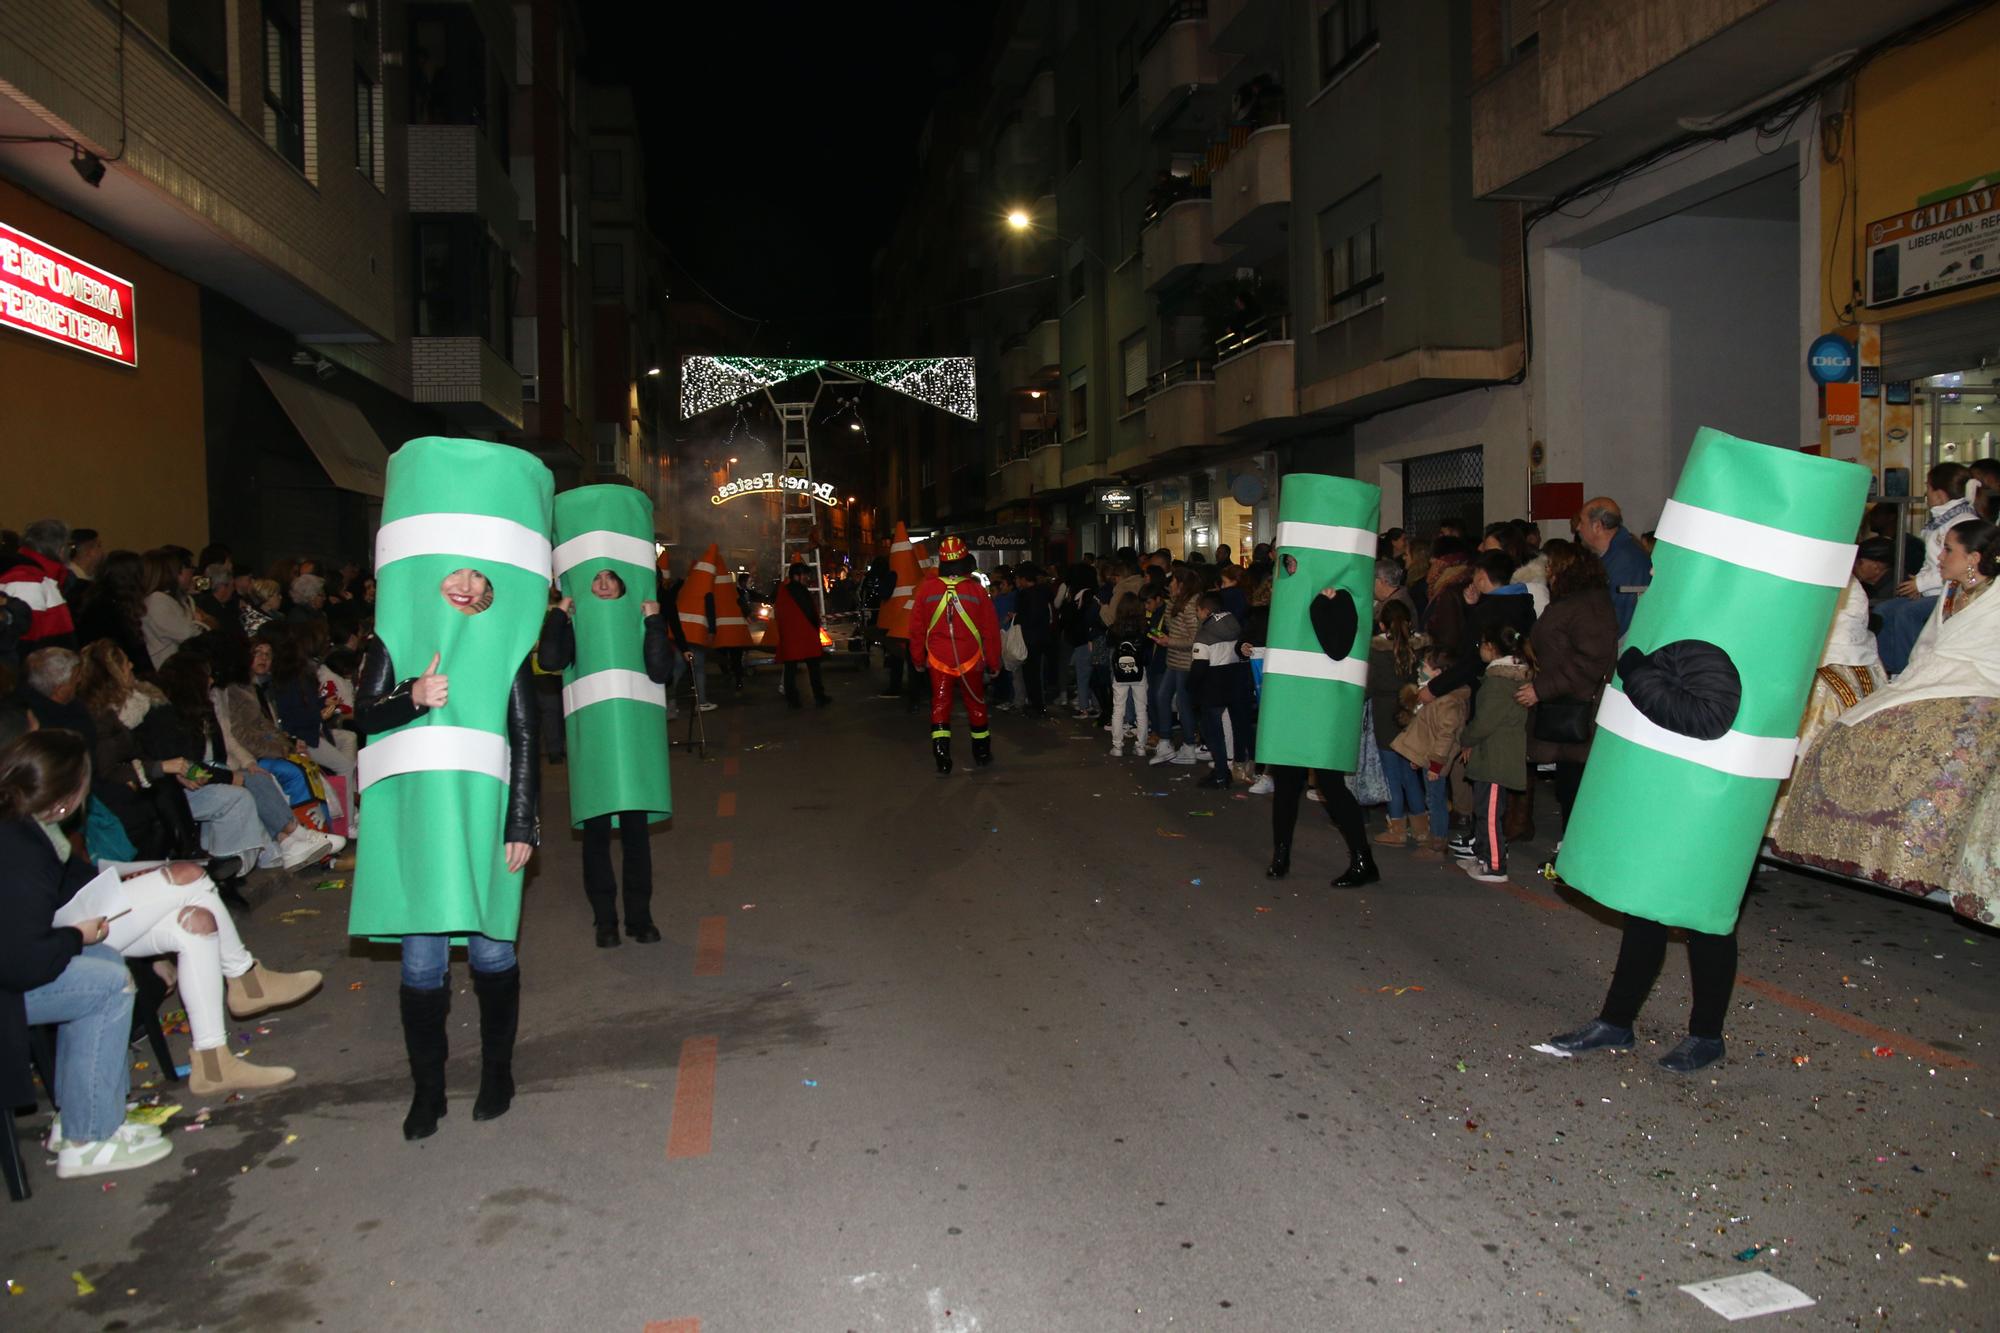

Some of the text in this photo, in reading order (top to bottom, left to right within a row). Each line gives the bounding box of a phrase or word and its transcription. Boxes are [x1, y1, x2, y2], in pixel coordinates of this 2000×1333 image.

[1908, 221, 1974, 250] LIBERACIÓN
[1812, 356, 1851, 367] DIGI
[1827, 413, 1856, 424] orange
